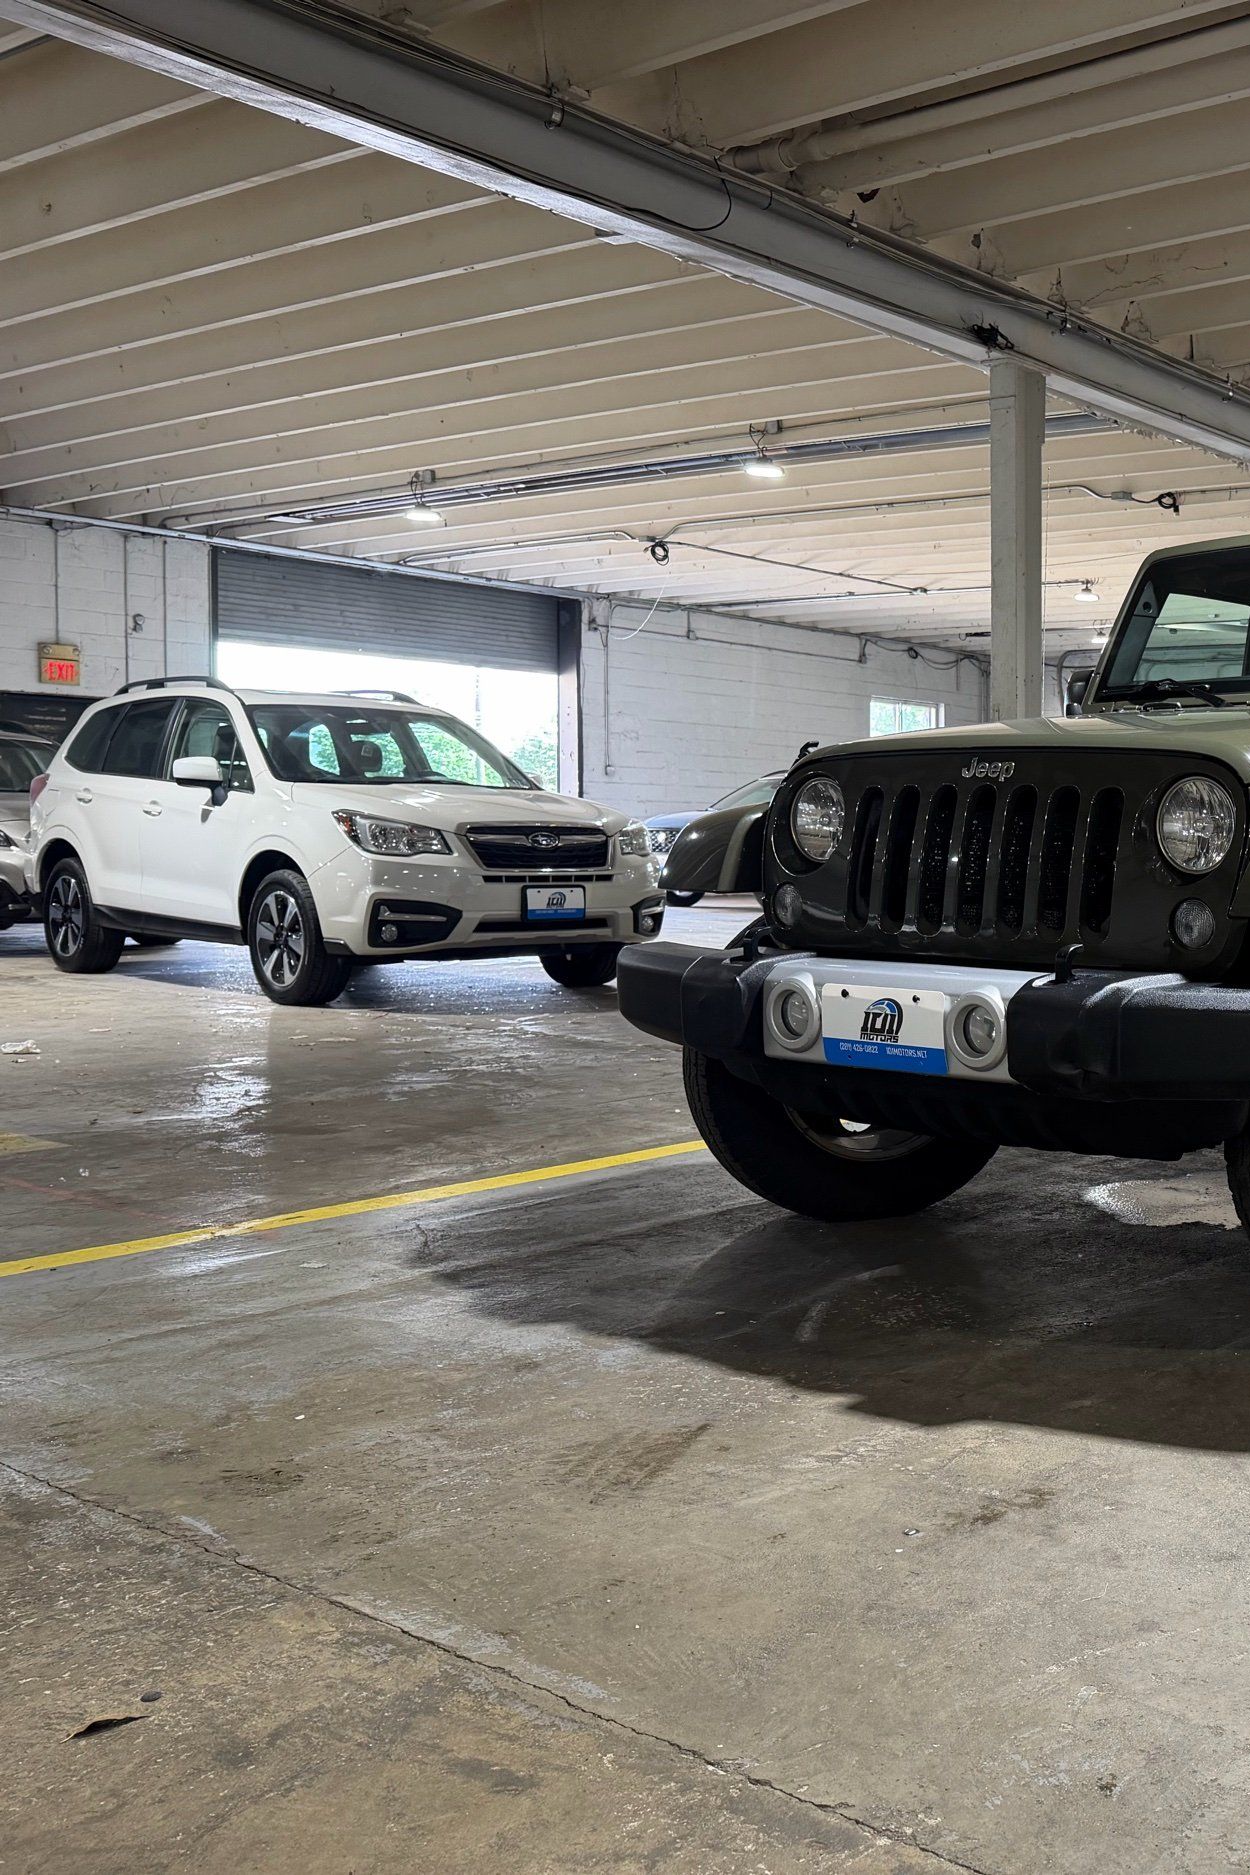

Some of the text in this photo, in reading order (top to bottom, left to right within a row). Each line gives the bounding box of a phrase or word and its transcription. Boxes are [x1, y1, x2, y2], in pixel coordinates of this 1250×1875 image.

[48, 661, 76, 681] EXIT
[961, 757, 1015, 782] Jeep
[860, 1011, 898, 1036] 101
[860, 1032, 899, 1044] MOTORS
[886, 1046, 928, 1058] 101MOTORS.NET
